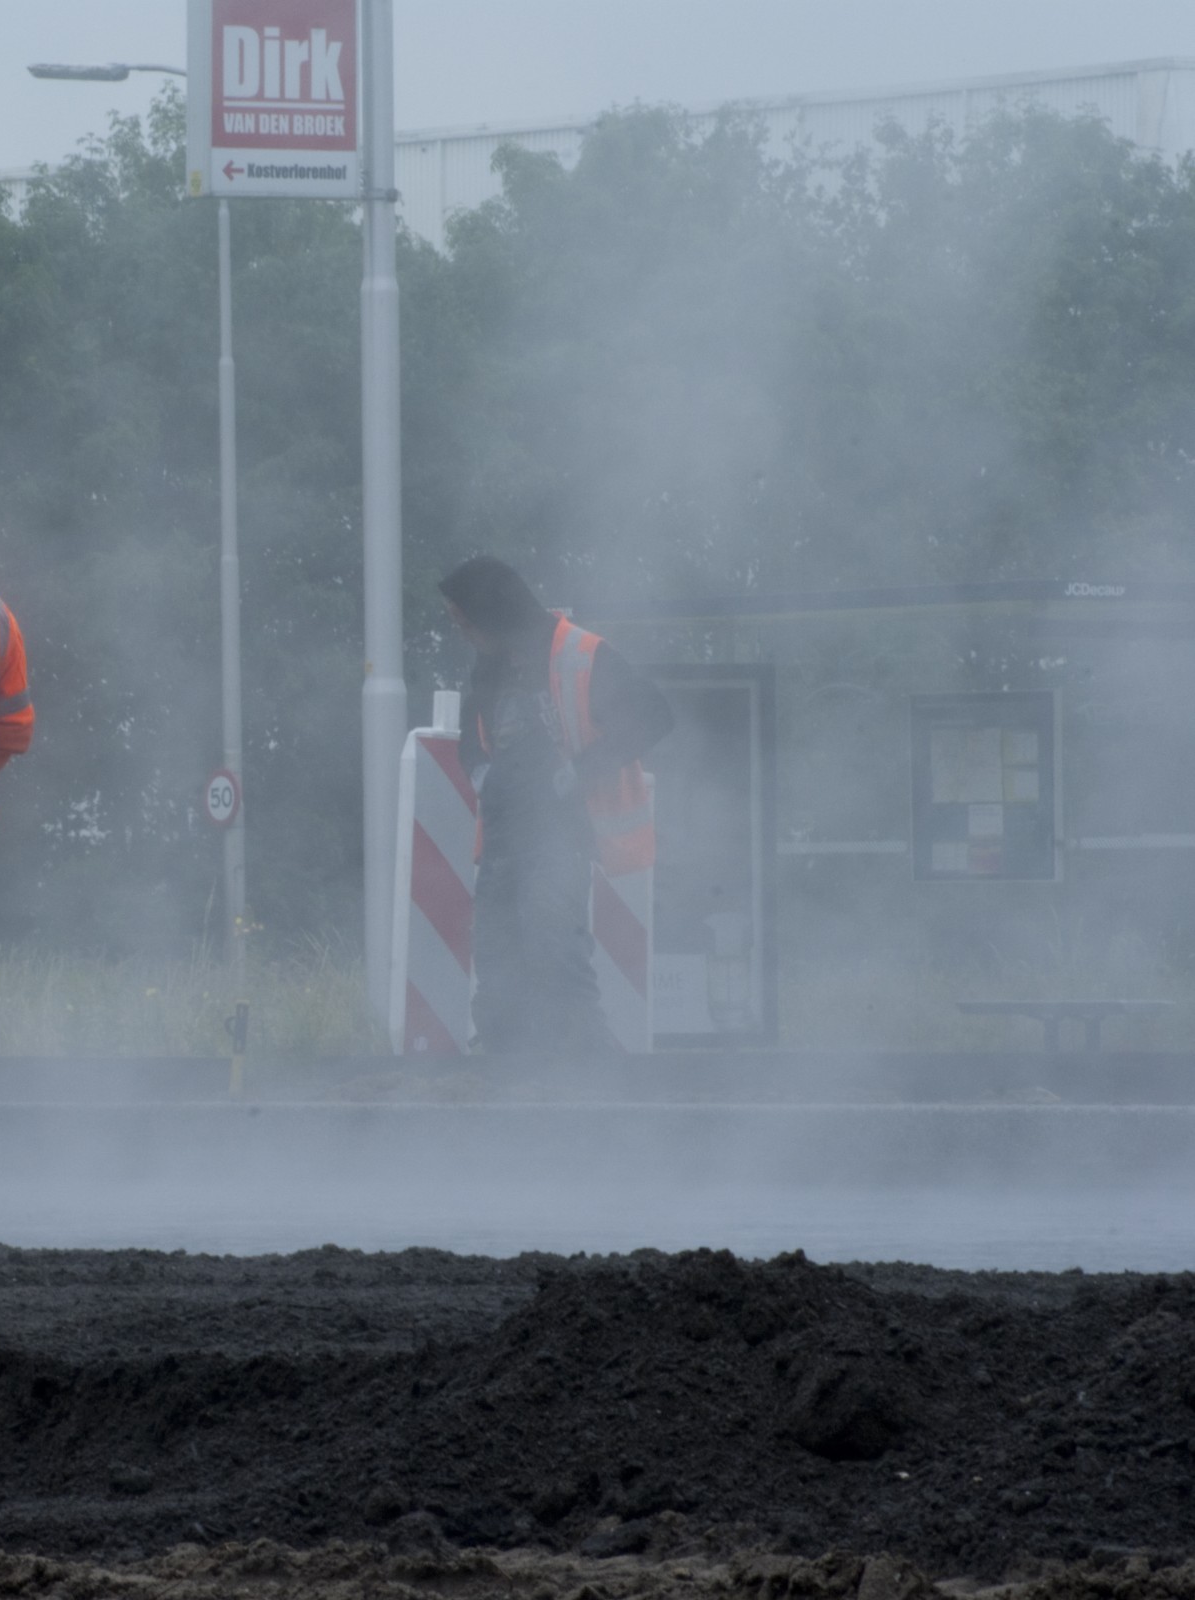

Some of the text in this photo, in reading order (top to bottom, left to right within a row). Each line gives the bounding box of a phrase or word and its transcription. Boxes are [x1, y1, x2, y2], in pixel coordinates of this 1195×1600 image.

[222, 25, 345, 100] Dirk
[223, 113, 346, 136] VAN DEN BROEK
[247, 163, 347, 180] Kostverlorenhof
[210, 786, 233, 808] 50
